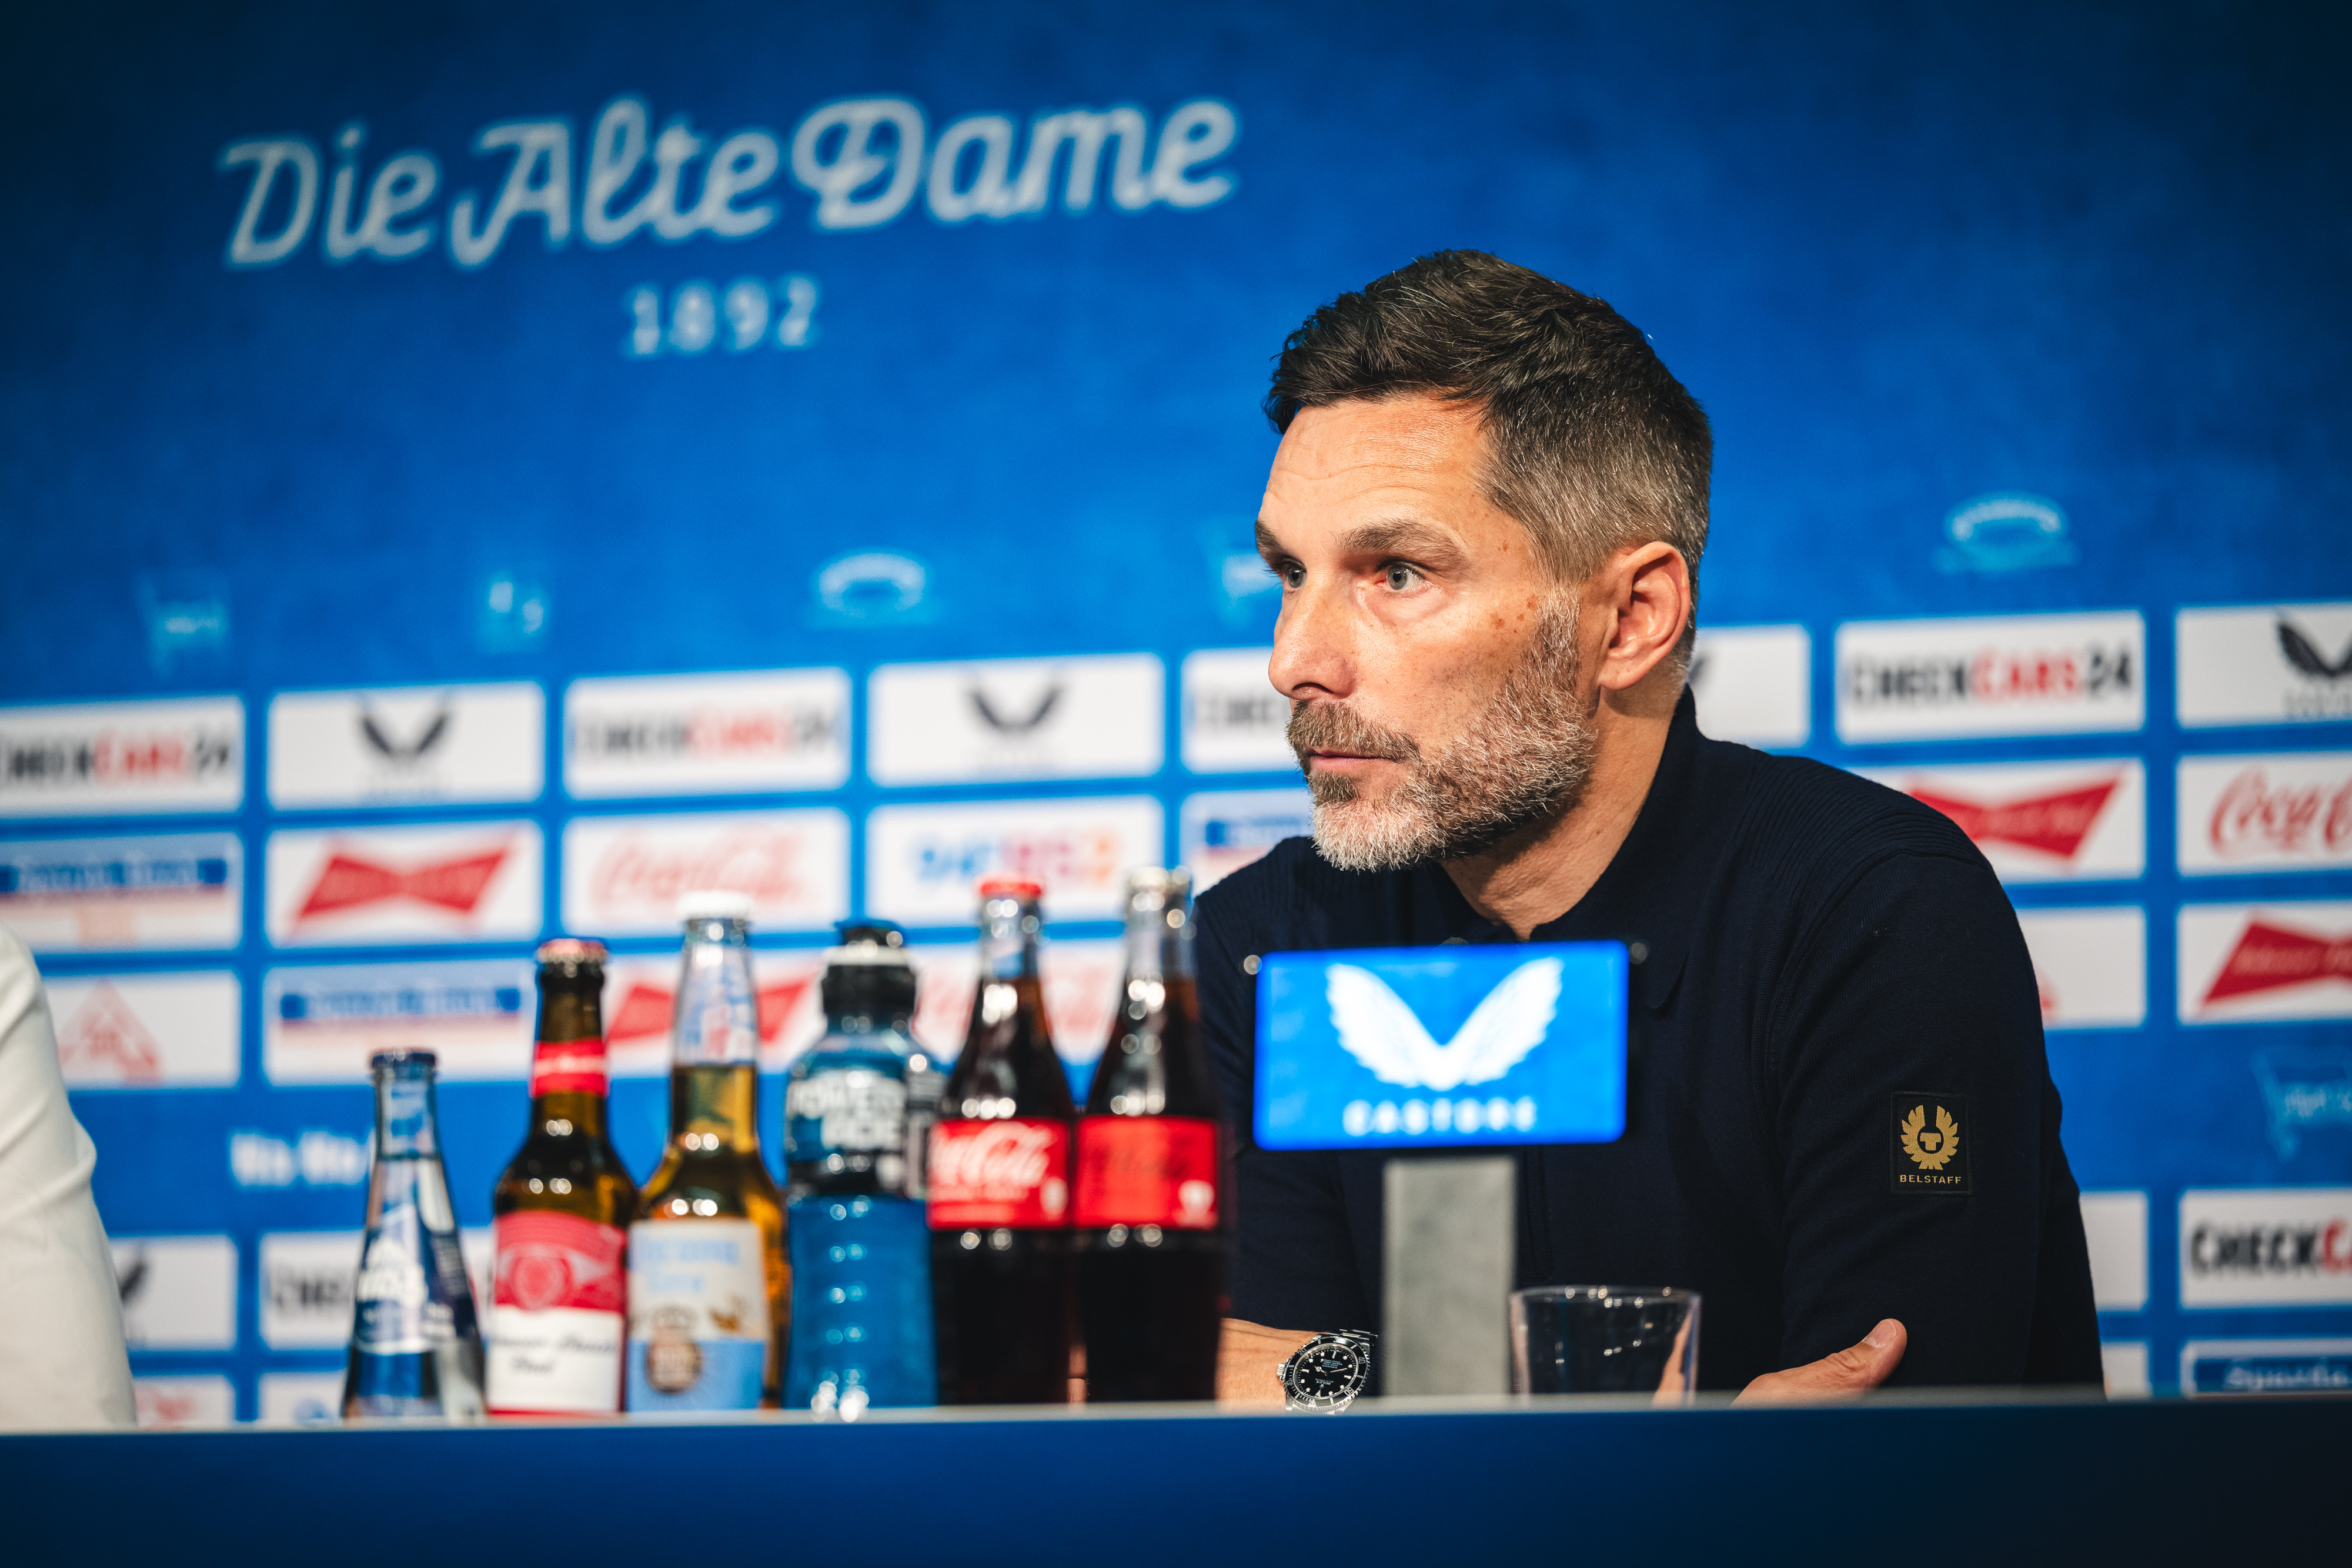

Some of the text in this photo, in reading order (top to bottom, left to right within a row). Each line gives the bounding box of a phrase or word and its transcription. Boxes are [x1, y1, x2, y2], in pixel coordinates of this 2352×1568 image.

[222, 94, 1240, 268] Die Alte Dame
[627, 276, 820, 356] 1892
[1845, 642, 2136, 708] CHECKCARS24
[1900, 1175, 1962, 1184] BELSTAFF
[1344, 1386, 1354, 1396] 50
